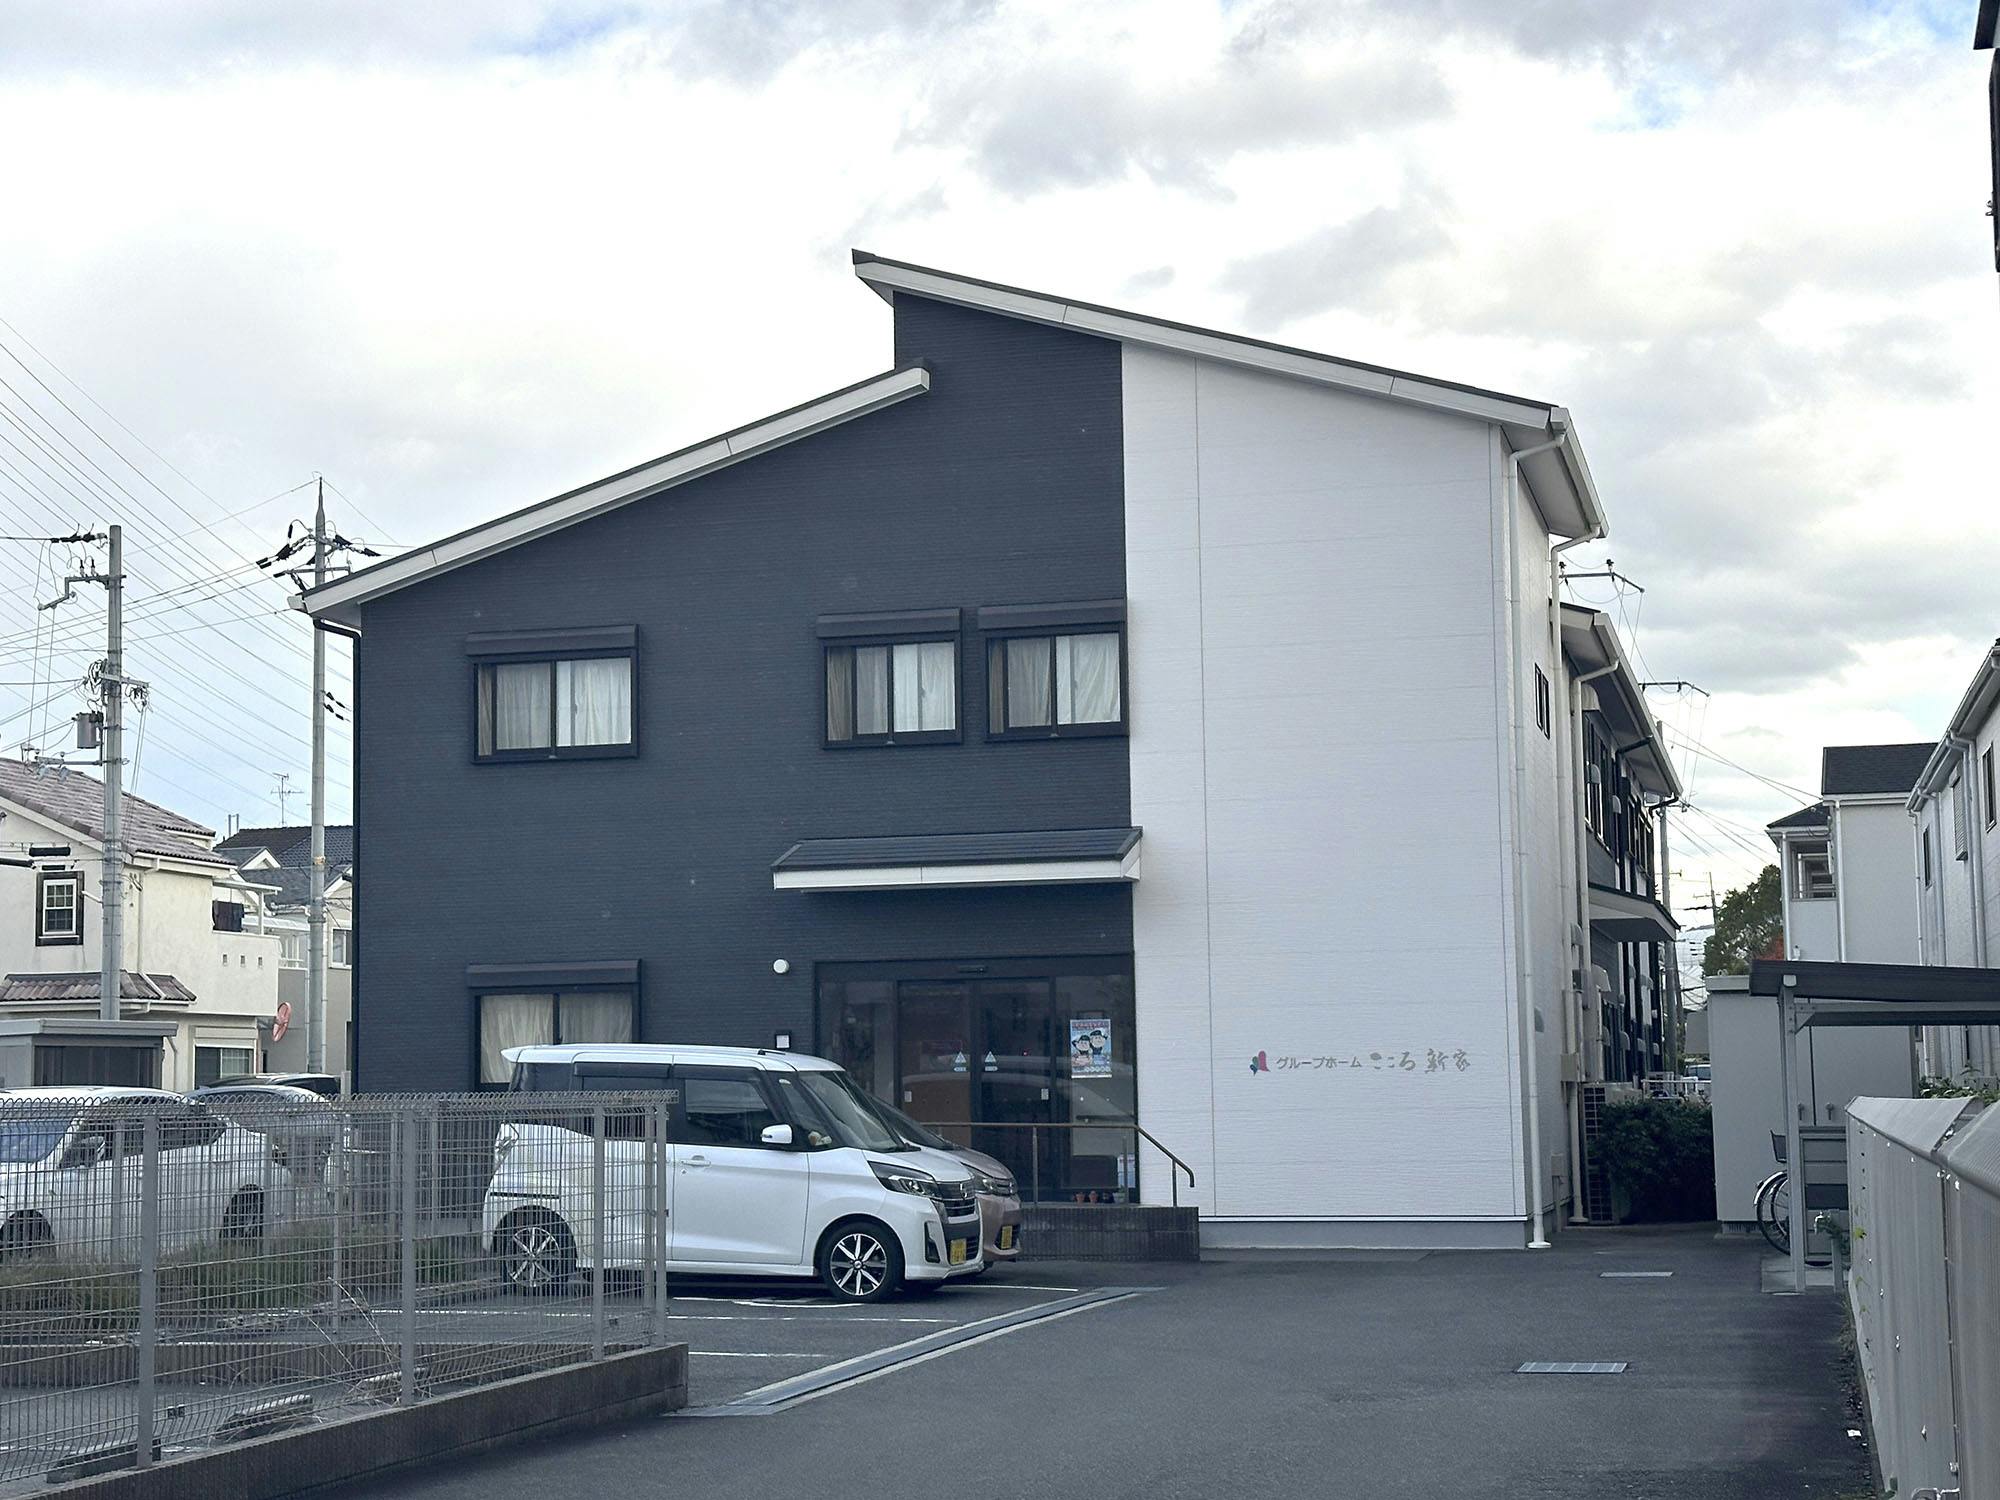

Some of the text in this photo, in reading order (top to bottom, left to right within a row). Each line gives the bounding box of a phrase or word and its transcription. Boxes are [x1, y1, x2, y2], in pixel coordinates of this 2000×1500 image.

[1276, 1056, 1363, 1070] グループホーム
